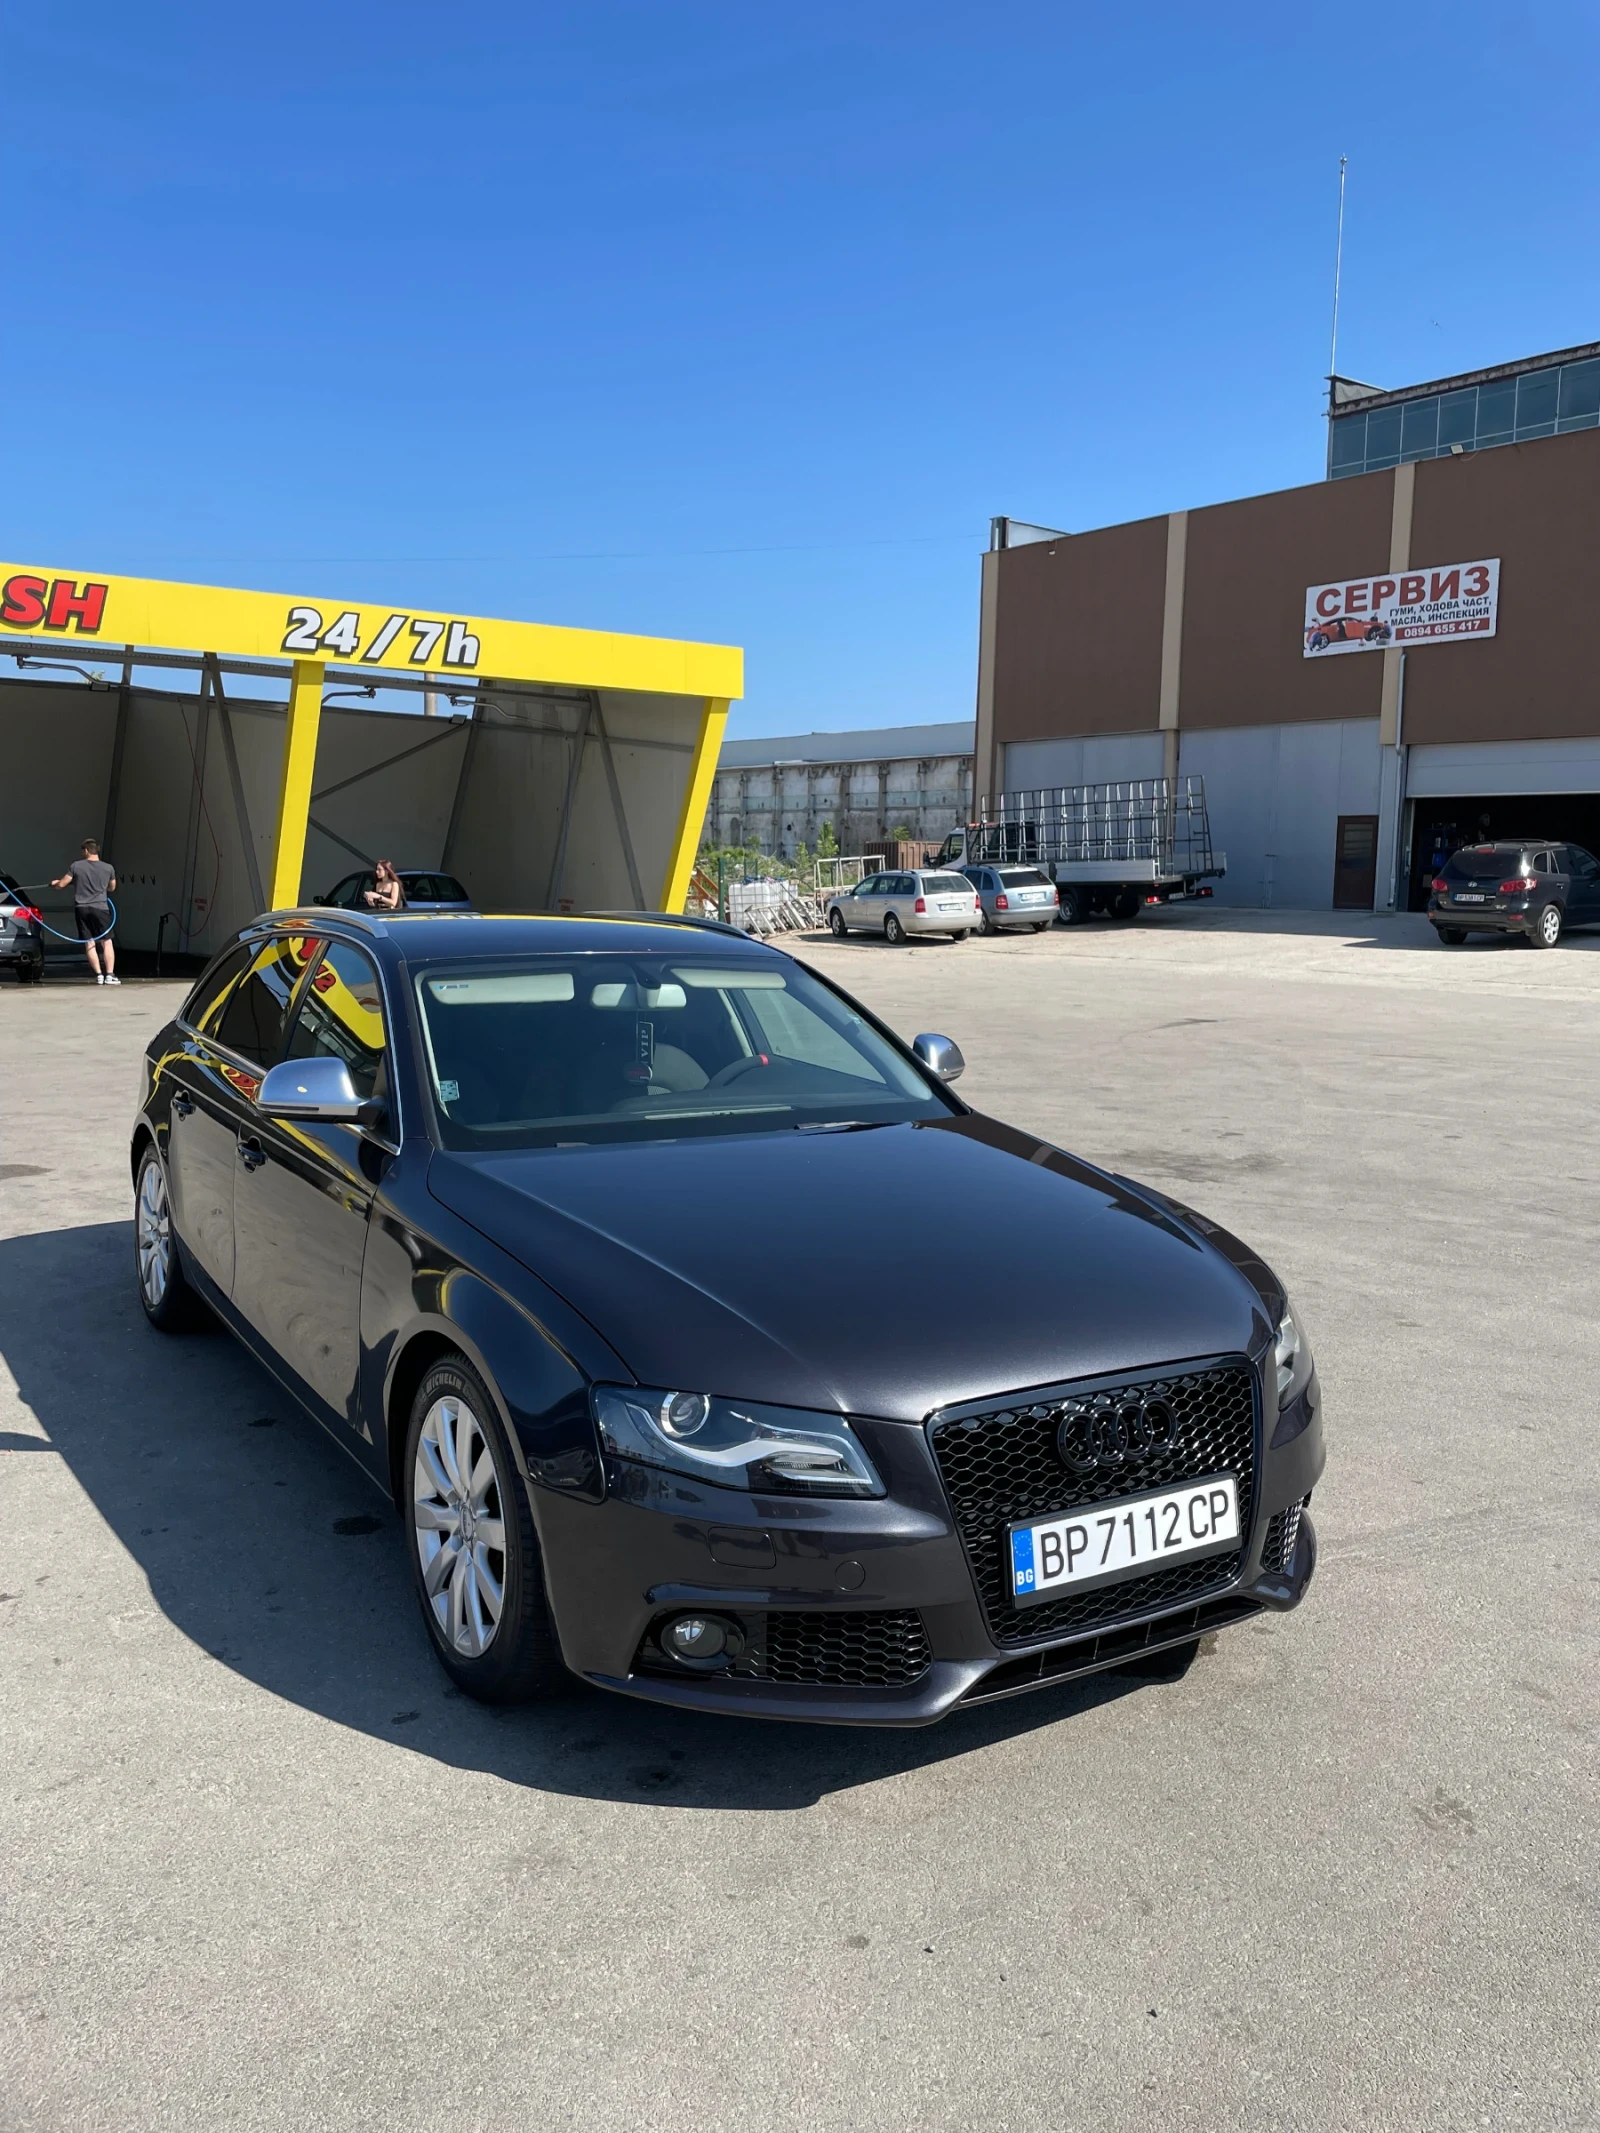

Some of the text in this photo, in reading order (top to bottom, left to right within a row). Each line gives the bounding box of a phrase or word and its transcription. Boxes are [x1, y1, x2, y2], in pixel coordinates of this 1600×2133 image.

[1316, 566, 1490, 617] СЕРВИЗ
[1, 575, 108, 634] SH
[1389, 596, 1492, 617] ГУМИ, ХОДОВА ЧАСТ,
[1391, 606, 1490, 626] МАСЛА, ИНСПЕКЦИЯ
[282, 606, 480, 667] 24/7h
[1404, 620, 1481, 638] 0894 655 417
[426, 1372, 463, 1394] MICHELIN
[1016, 1570, 1034, 1586] BG
